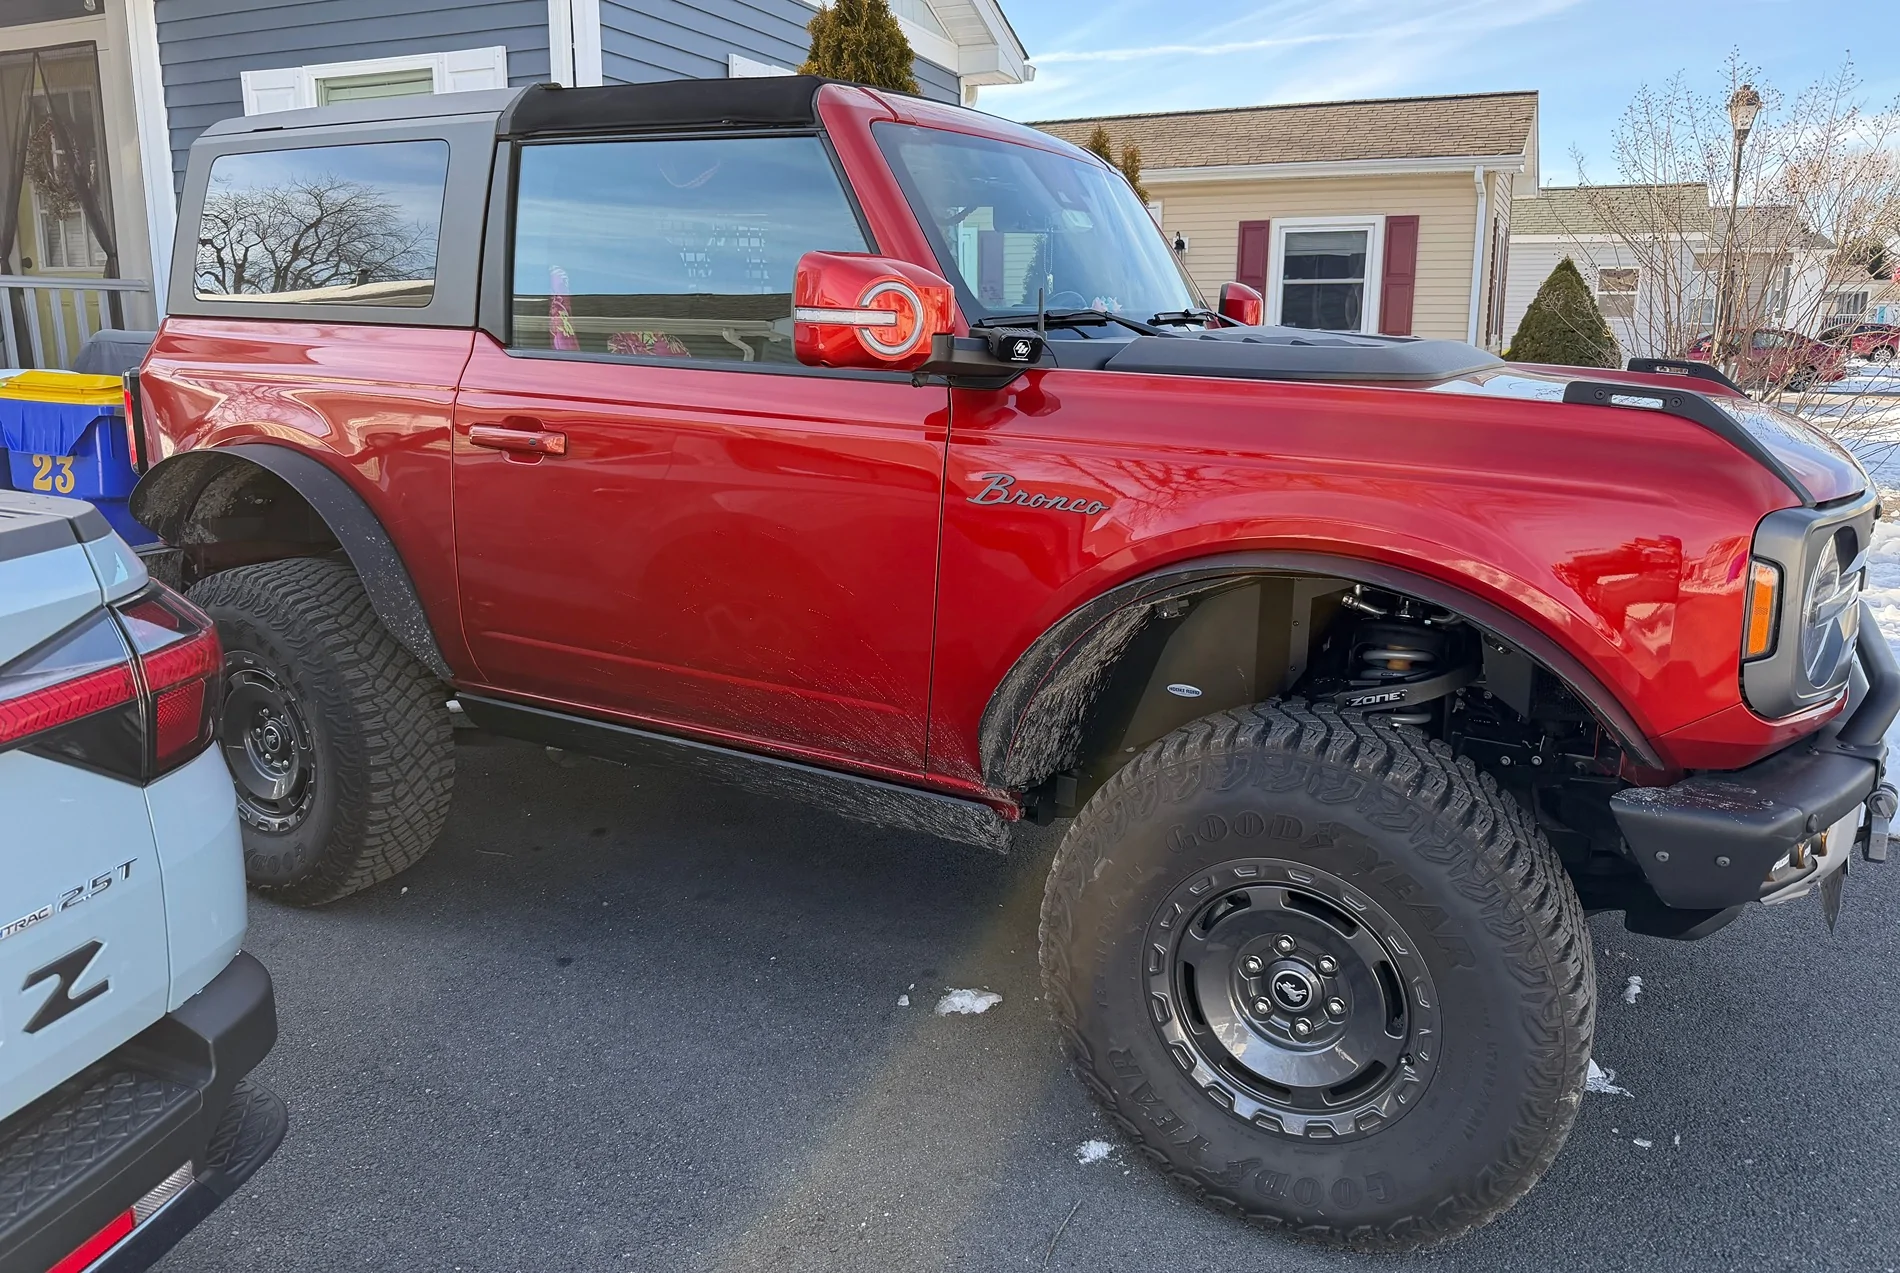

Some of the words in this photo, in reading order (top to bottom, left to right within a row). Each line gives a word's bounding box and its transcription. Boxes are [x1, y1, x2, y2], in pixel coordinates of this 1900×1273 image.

[32, 454, 75, 494] 23
[966, 472, 1110, 515] Bronco
[1350, 691, 1400, 706] ZONE
